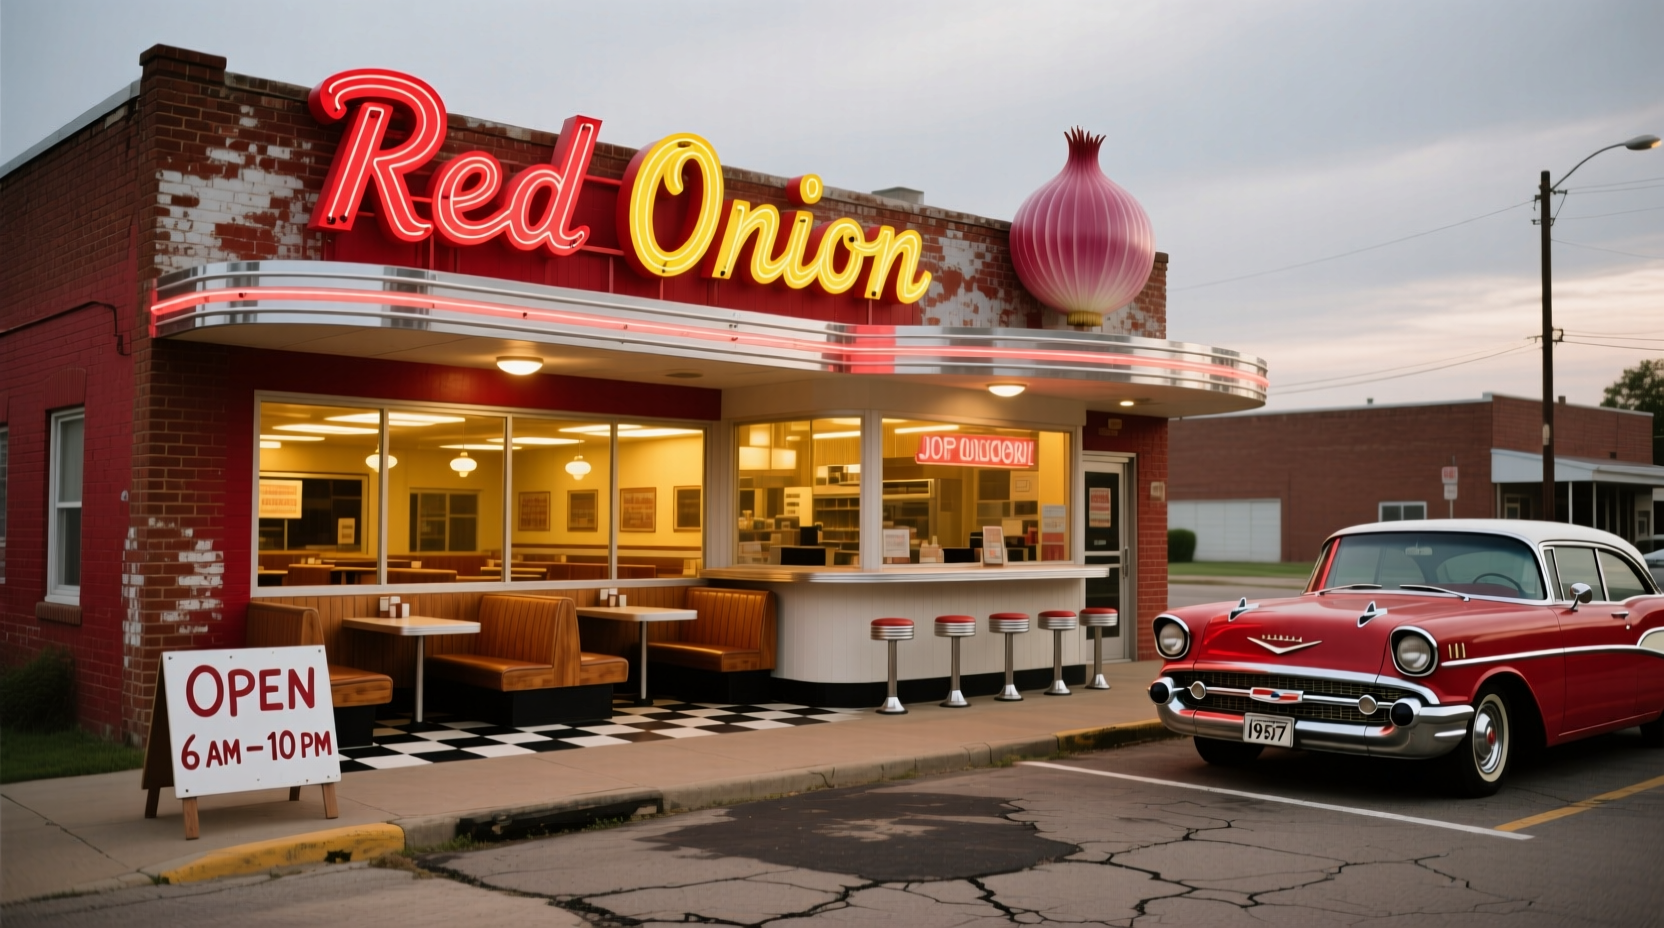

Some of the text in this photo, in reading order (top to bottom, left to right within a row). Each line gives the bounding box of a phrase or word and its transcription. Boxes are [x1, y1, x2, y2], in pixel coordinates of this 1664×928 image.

[308, 68, 932, 304] Red Onion
[185, 664, 316, 718] OPEN
[180, 733, 201, 771] 6
[205, 738, 242, 768] AM
[266, 729, 297, 761] 10
[300, 730, 333, 759] PM
